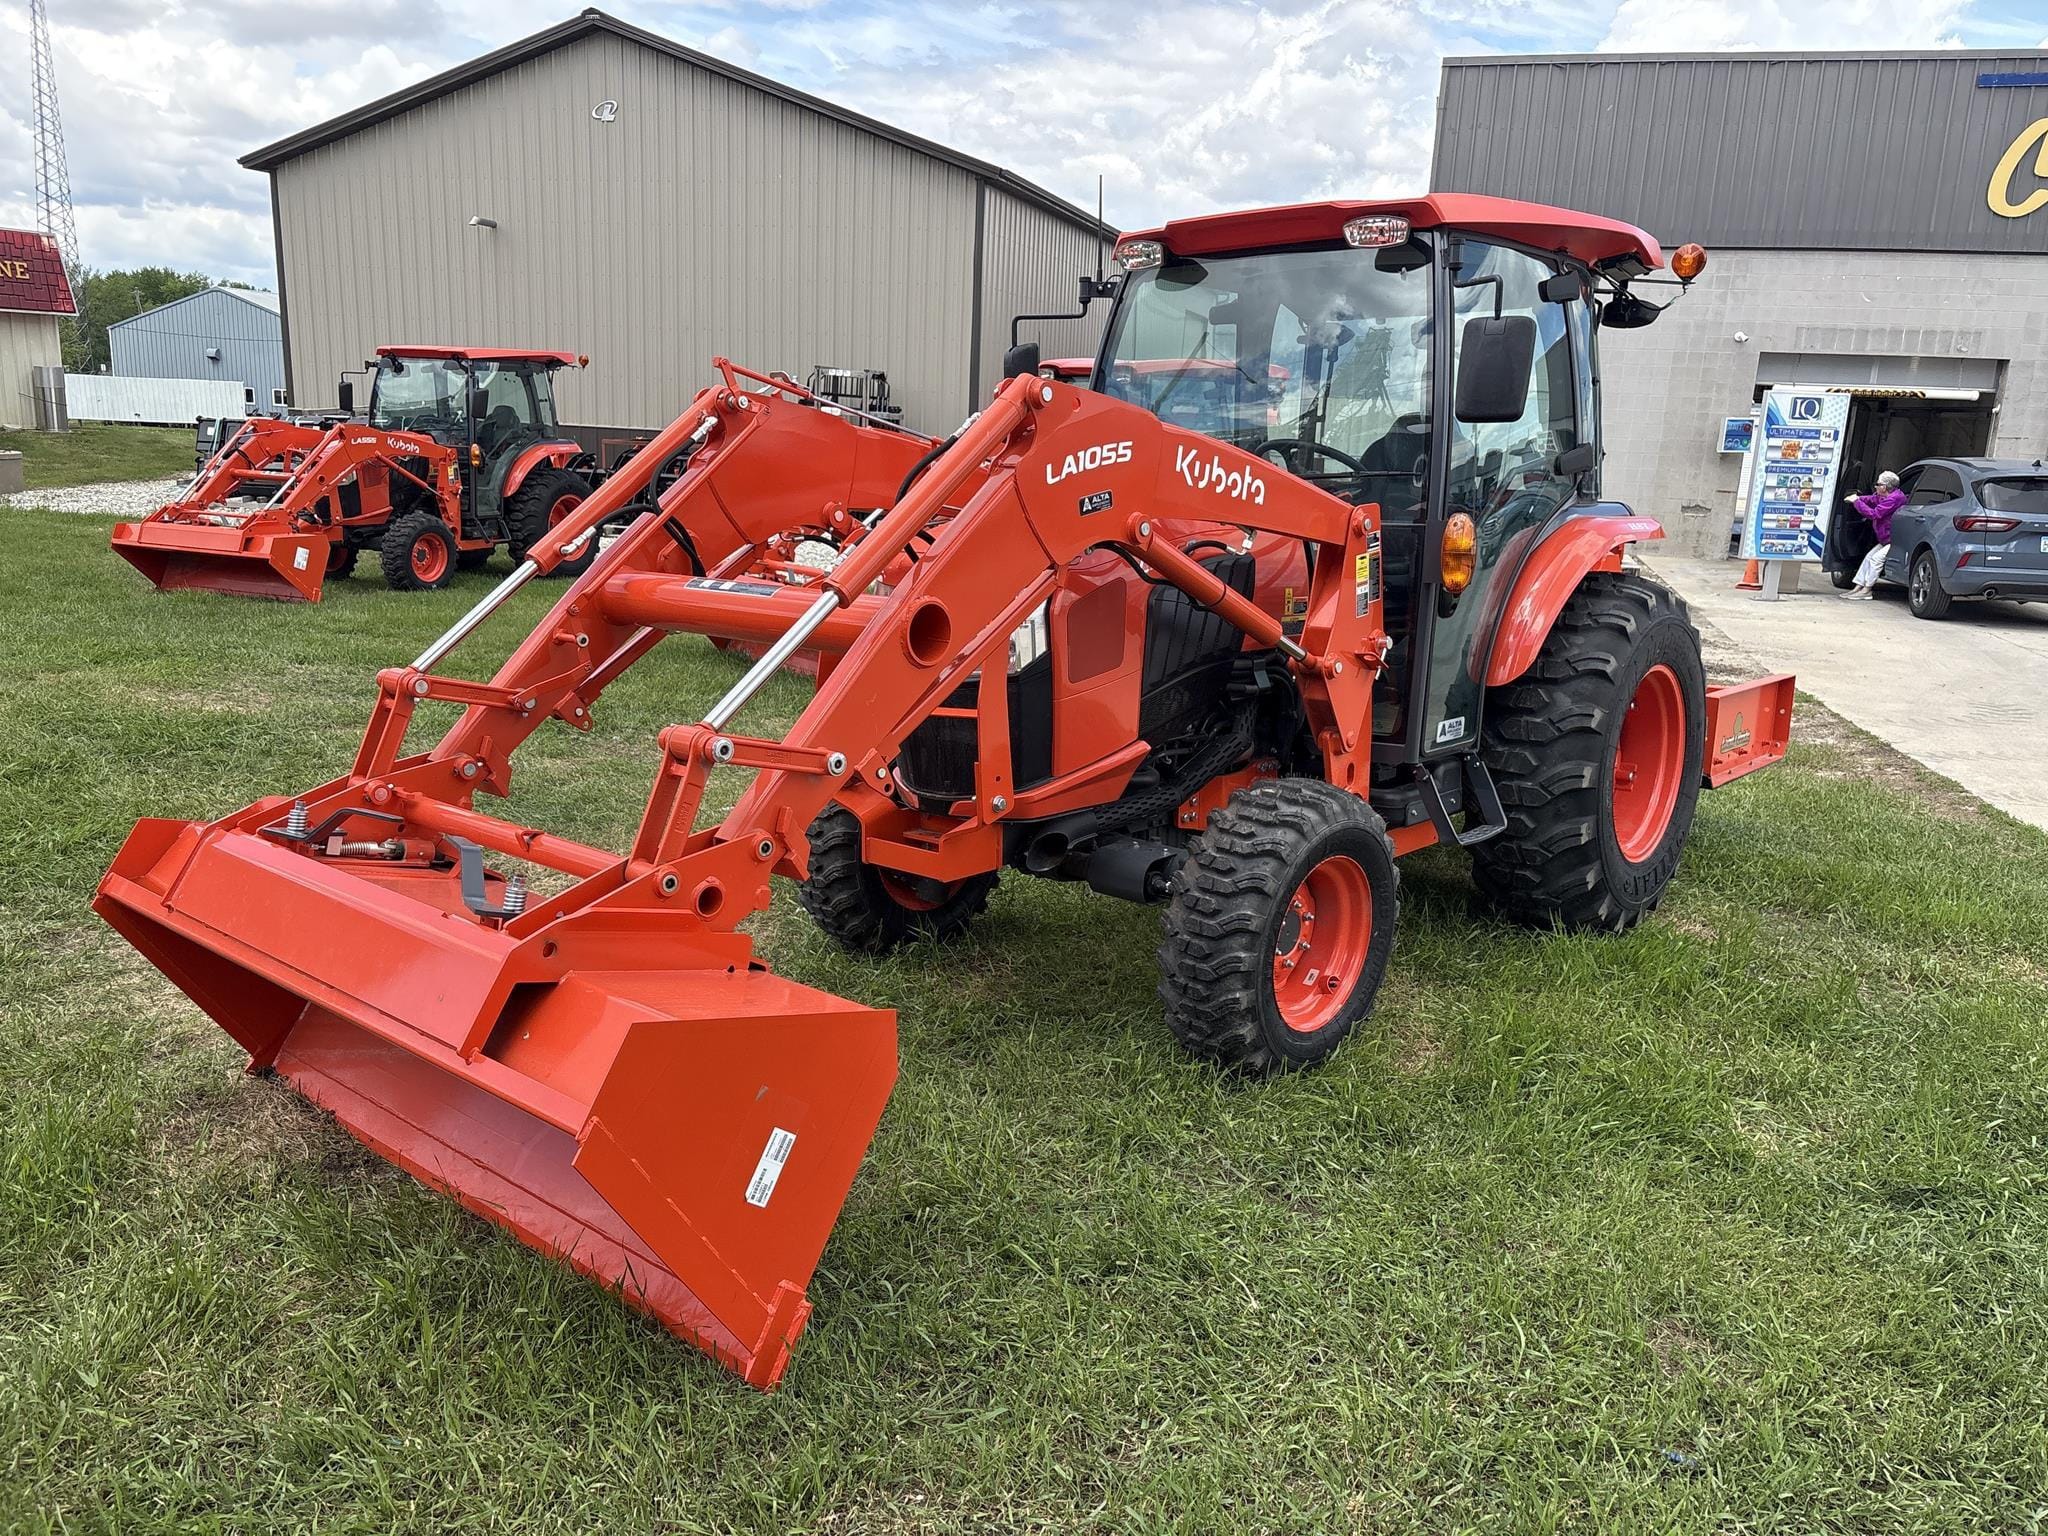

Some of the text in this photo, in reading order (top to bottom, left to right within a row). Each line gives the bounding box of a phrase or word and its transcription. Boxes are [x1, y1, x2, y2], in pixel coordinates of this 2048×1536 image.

[1792, 399, 1820, 422] IQ
[1769, 428, 1804, 436] ULTIMATE
[387, 436, 420, 454] Kubota
[1045, 441, 1133, 485] LA1055
[1175, 444, 1265, 506] Kubota
[1092, 493, 1110, 504] ALTA
[1448, 719, 1462, 730] ALTA
